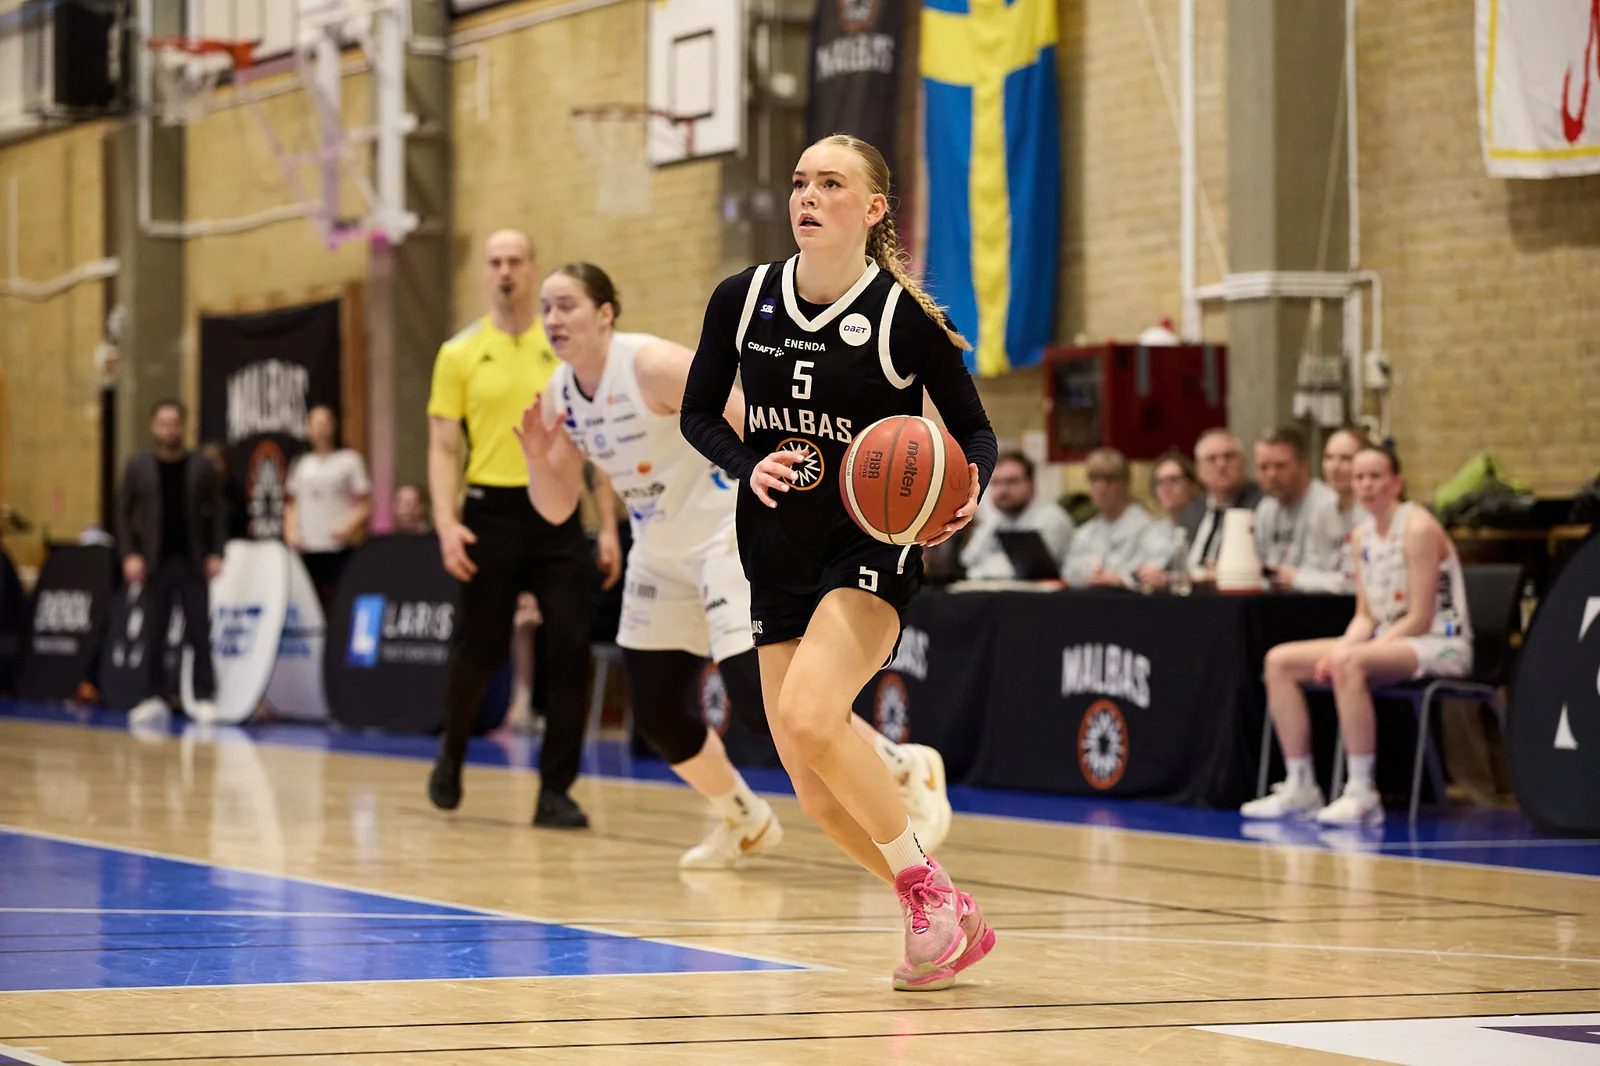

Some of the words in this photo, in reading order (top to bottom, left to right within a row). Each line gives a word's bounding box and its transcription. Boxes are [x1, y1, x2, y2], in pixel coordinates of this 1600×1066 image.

[747, 341, 776, 356] CRAFT
[784, 338, 826, 352] ENENDA
[791, 360, 815, 400] 5
[749, 404, 853, 443] MALBAS
[868, 451, 883, 479] FIBA
[899, 440, 919, 498] molten
[858, 566, 878, 593] 5
[1061, 642, 1151, 709] MALBAS
